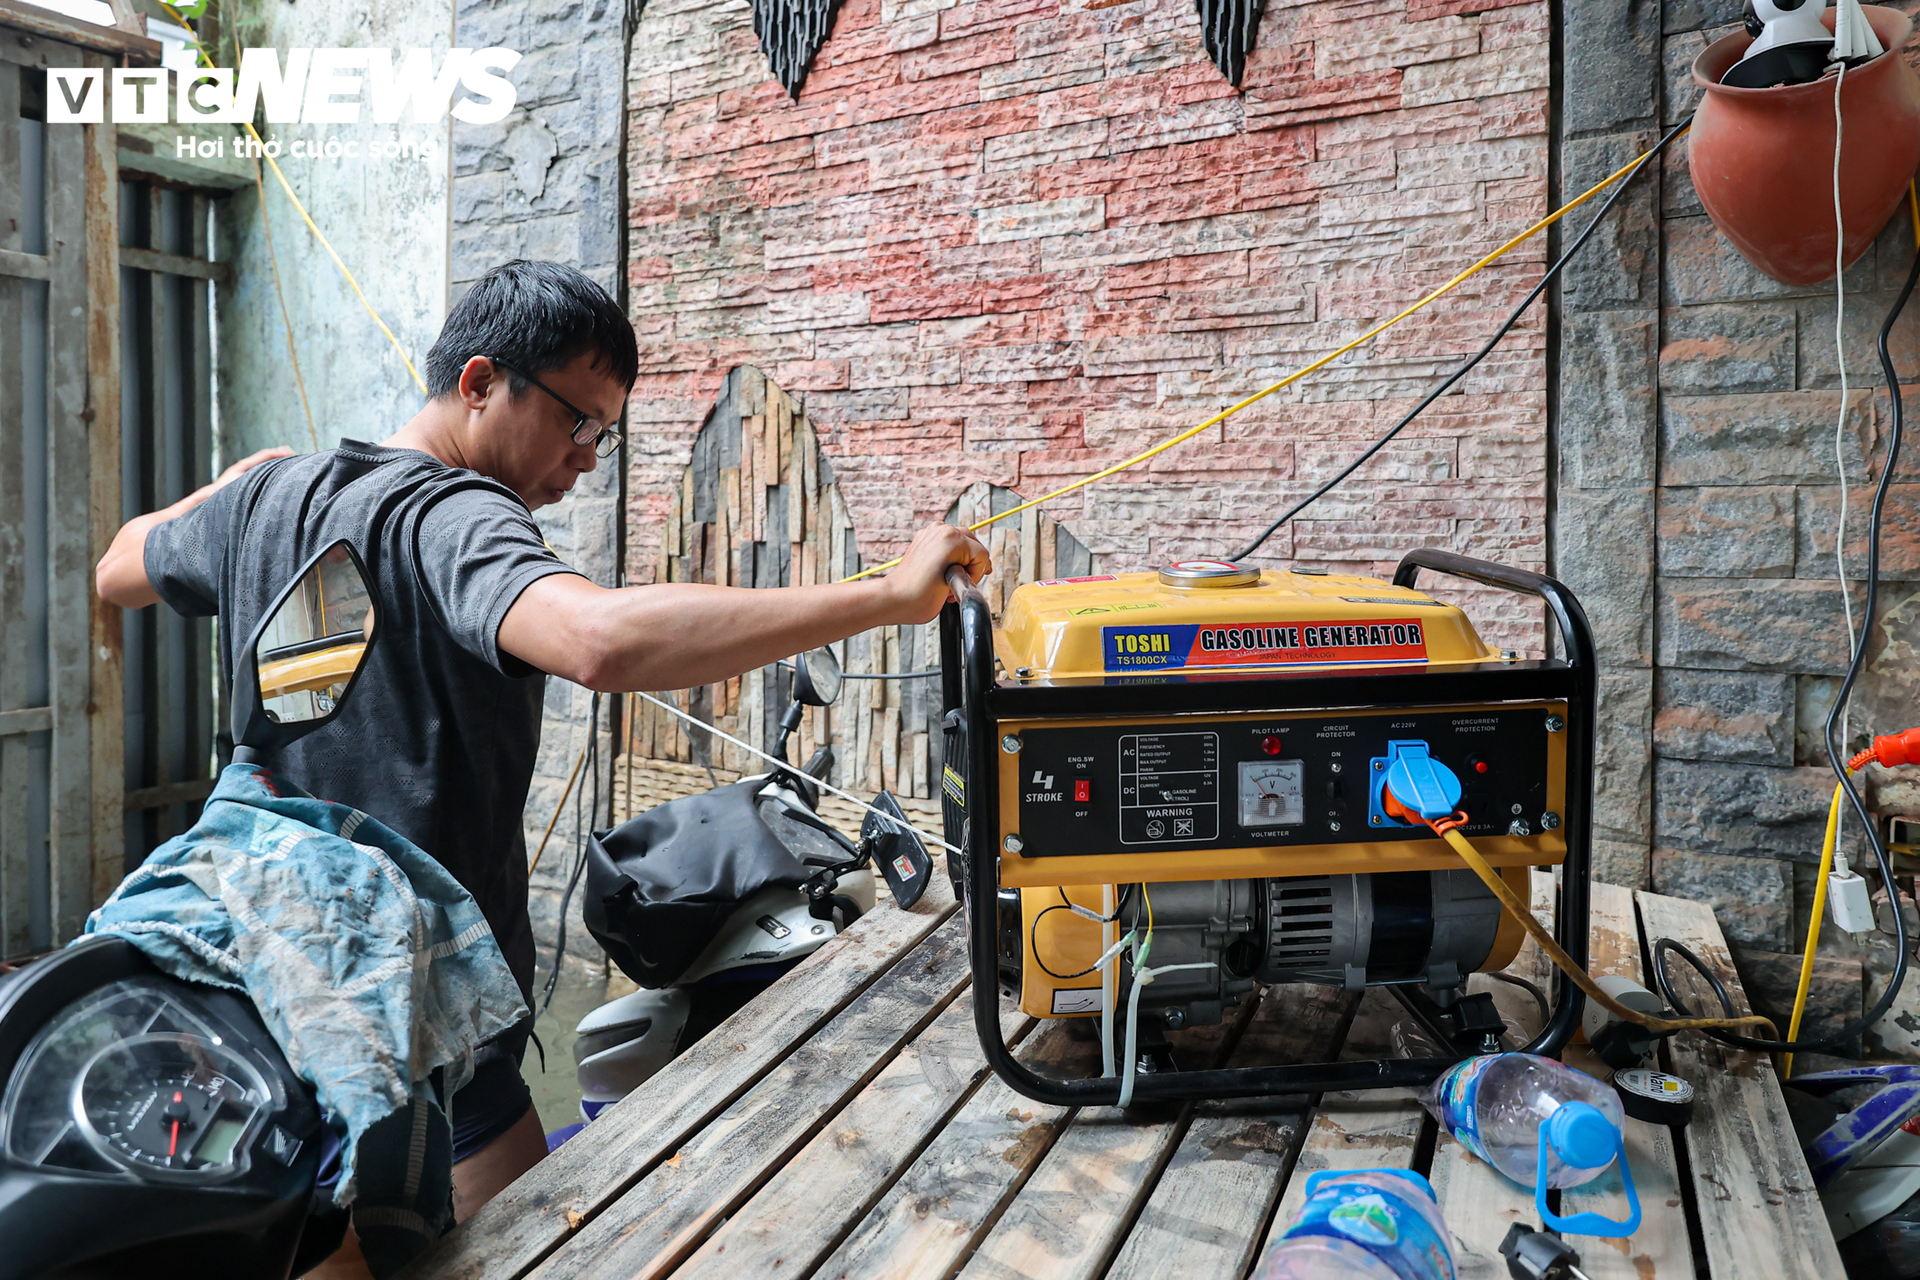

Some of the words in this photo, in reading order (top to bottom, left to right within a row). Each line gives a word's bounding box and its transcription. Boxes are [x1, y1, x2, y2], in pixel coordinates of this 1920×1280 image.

[1201, 627, 1300, 652] GASOLINE
[1304, 624, 1422, 649] GENERATOR
[1114, 634, 1171, 653] TOSHI
[1117, 656, 1168, 665] TS1800CX
[1285, 652, 1336, 660] TECHNOLOGY
[1452, 718, 1499, 726] OVERCURRENT
[1032, 770, 1054, 789] 4
[1269, 780, 1275, 789] V
[1025, 792, 1063, 802] STROKE
[1146, 807, 1193, 818] WARNING
[1251, 830, 1290, 838] VOLTMETER
